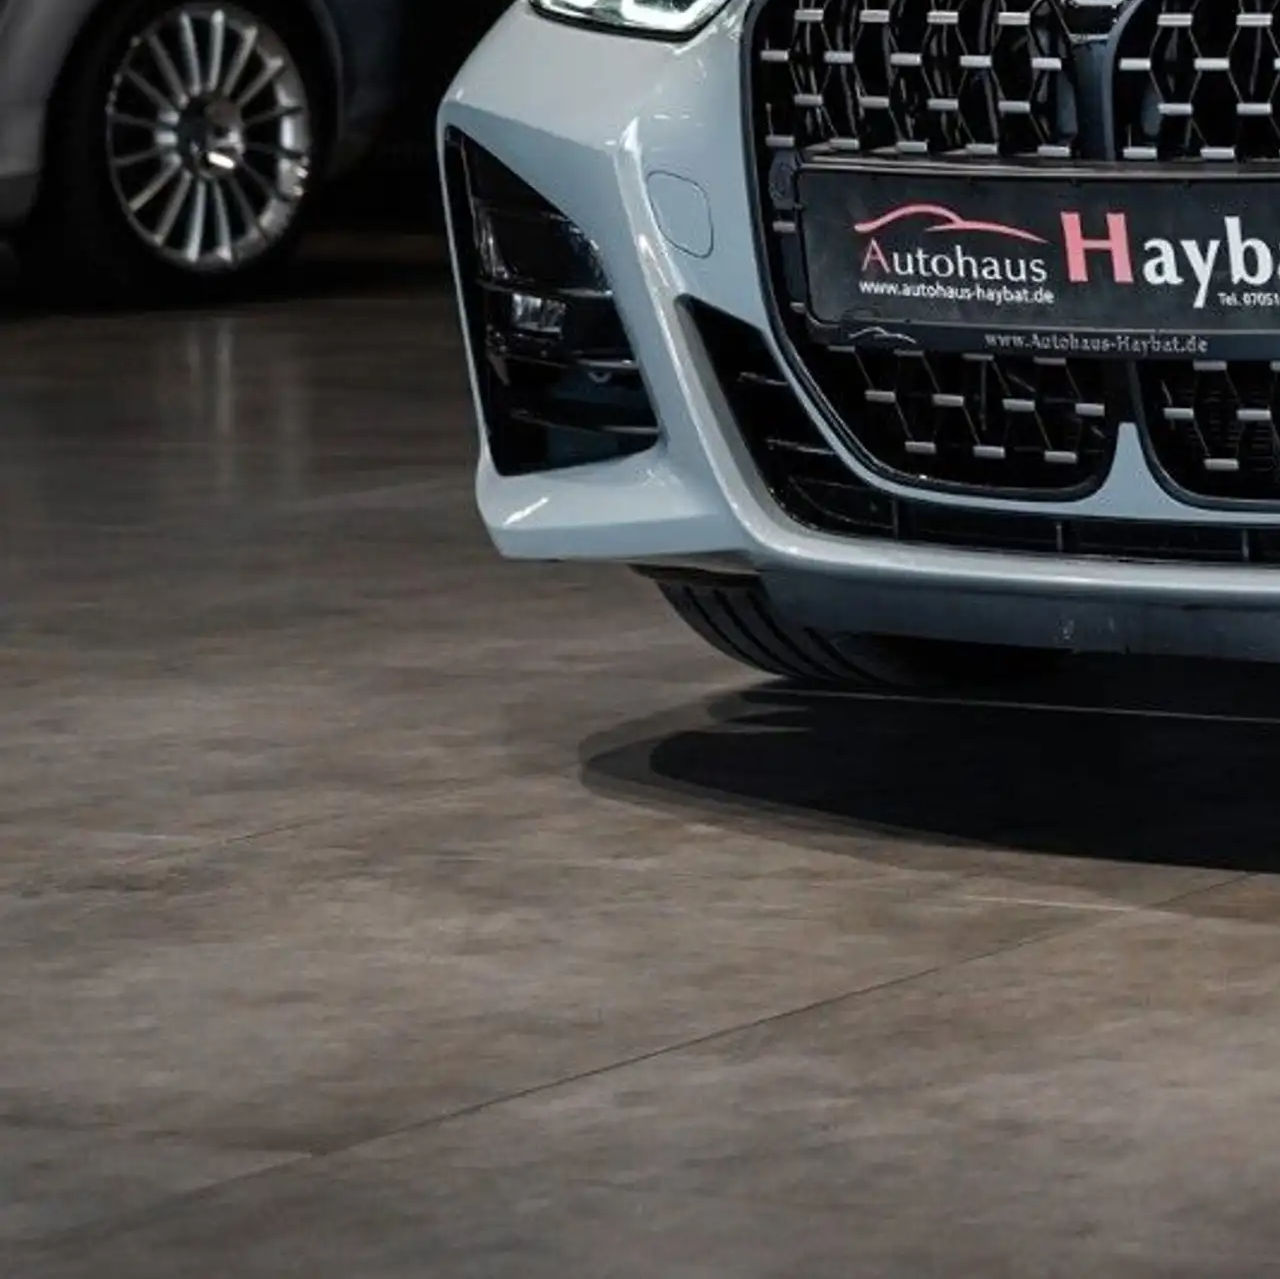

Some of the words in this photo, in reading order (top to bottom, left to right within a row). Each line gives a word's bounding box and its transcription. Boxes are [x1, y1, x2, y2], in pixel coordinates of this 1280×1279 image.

[860, 236, 1048, 283] Autohaus
[858, 279, 1055, 306] www.autohaus-haybat.de
[1217, 292, 1242, 306] Tel.
[983, 332, 1208, 356] www.Autohaus-Haybat.de
